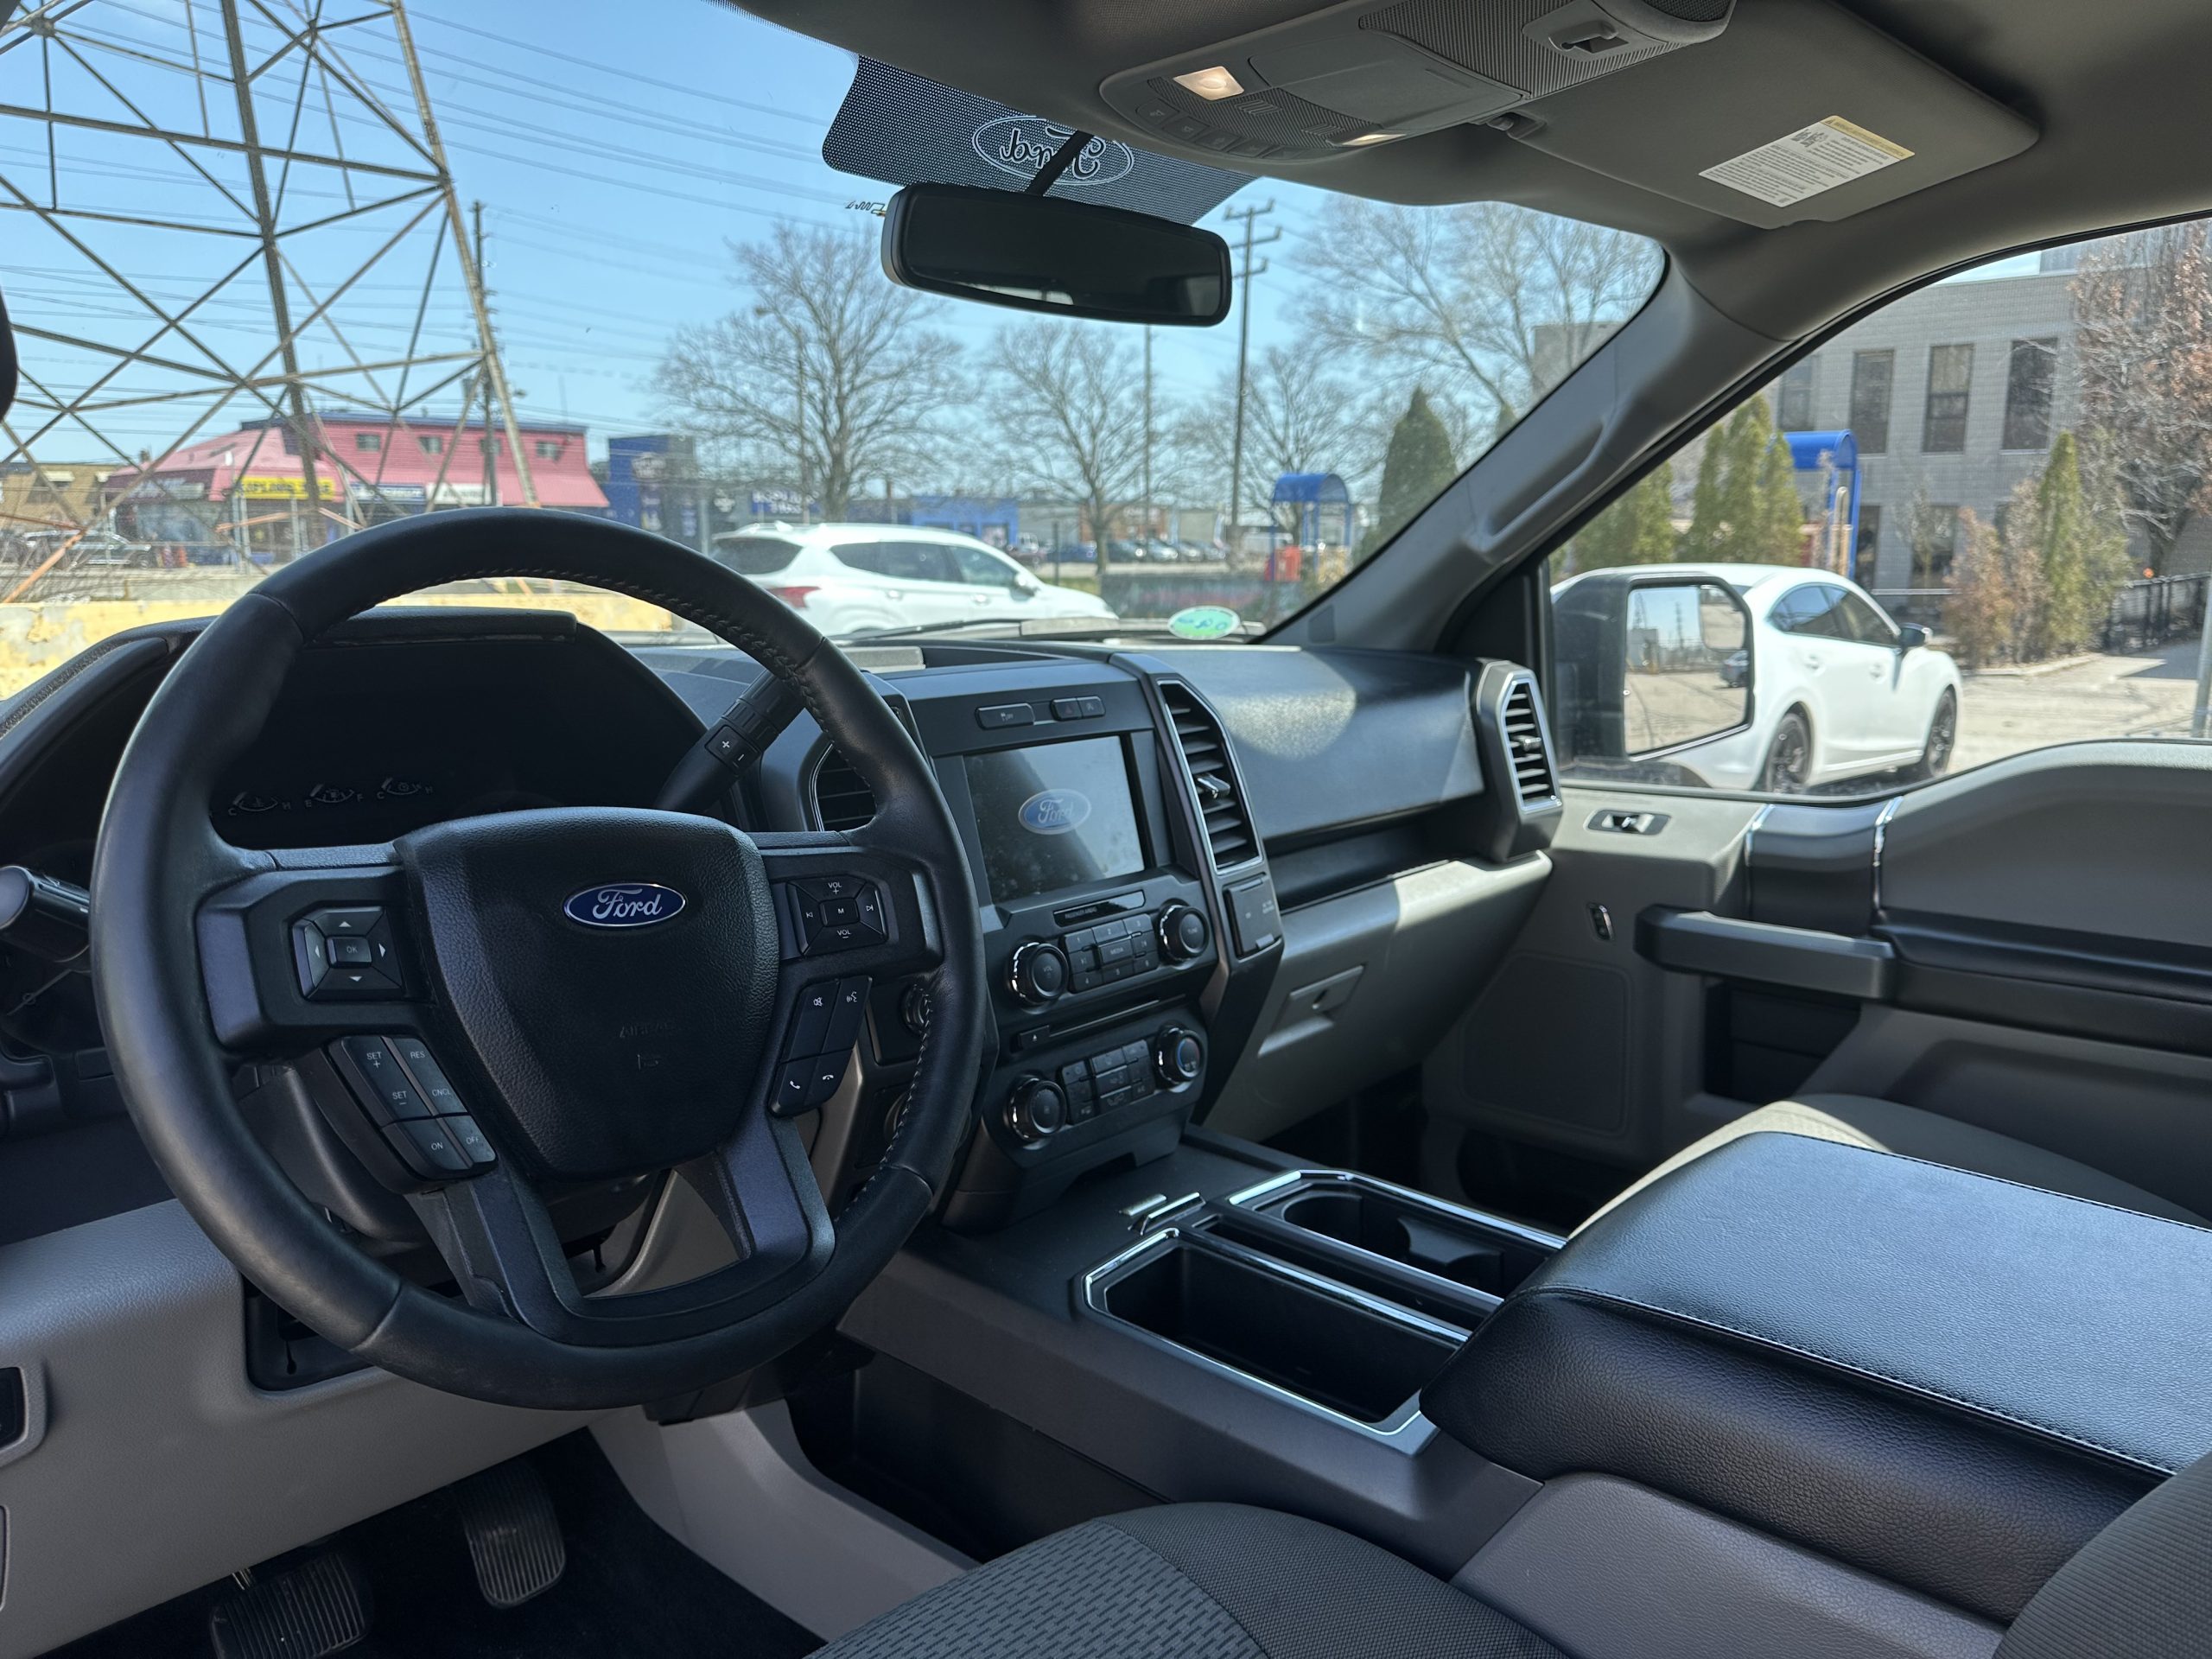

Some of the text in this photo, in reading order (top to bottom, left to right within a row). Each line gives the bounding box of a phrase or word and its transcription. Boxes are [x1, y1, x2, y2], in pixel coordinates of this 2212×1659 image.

[356, 793, 364, 802] F
[377, 791, 385, 800] C
[304, 800, 313, 809] E
[227, 807, 237, 817] C
[1037, 798, 1074, 824] Ford
[592, 887, 663, 920] Ford
[346, 944, 359, 954] OK
[366, 1052, 383, 1061] SET
[410, 1051, 426, 1059] RES
[391, 1090, 408, 1100] SET
[431, 1088, 451, 1097] CNCL
[466, 1136, 480, 1145] OFF
[430, 1141, 444, 1151] ON
